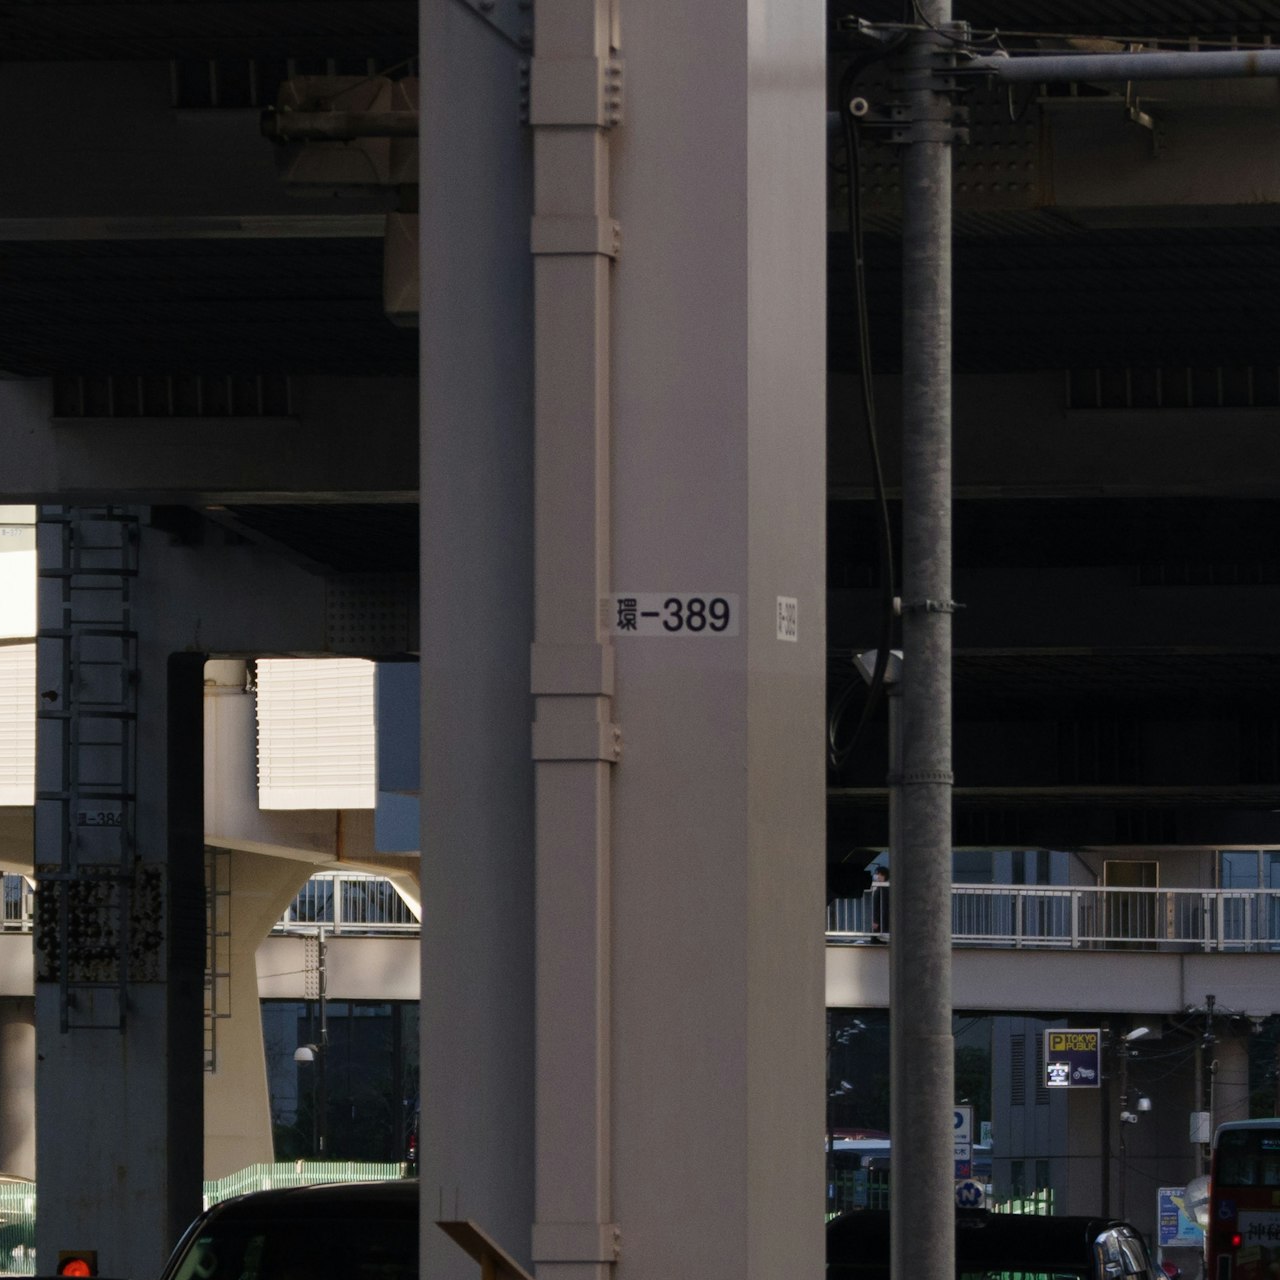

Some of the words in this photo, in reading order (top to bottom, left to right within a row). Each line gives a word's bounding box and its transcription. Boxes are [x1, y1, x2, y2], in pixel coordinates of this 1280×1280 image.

[616, 597, 730, 632] 環-389
[1066, 1034, 1097, 1042] TOKYO
[1066, 1042, 1097, 1051] PUBLIC
